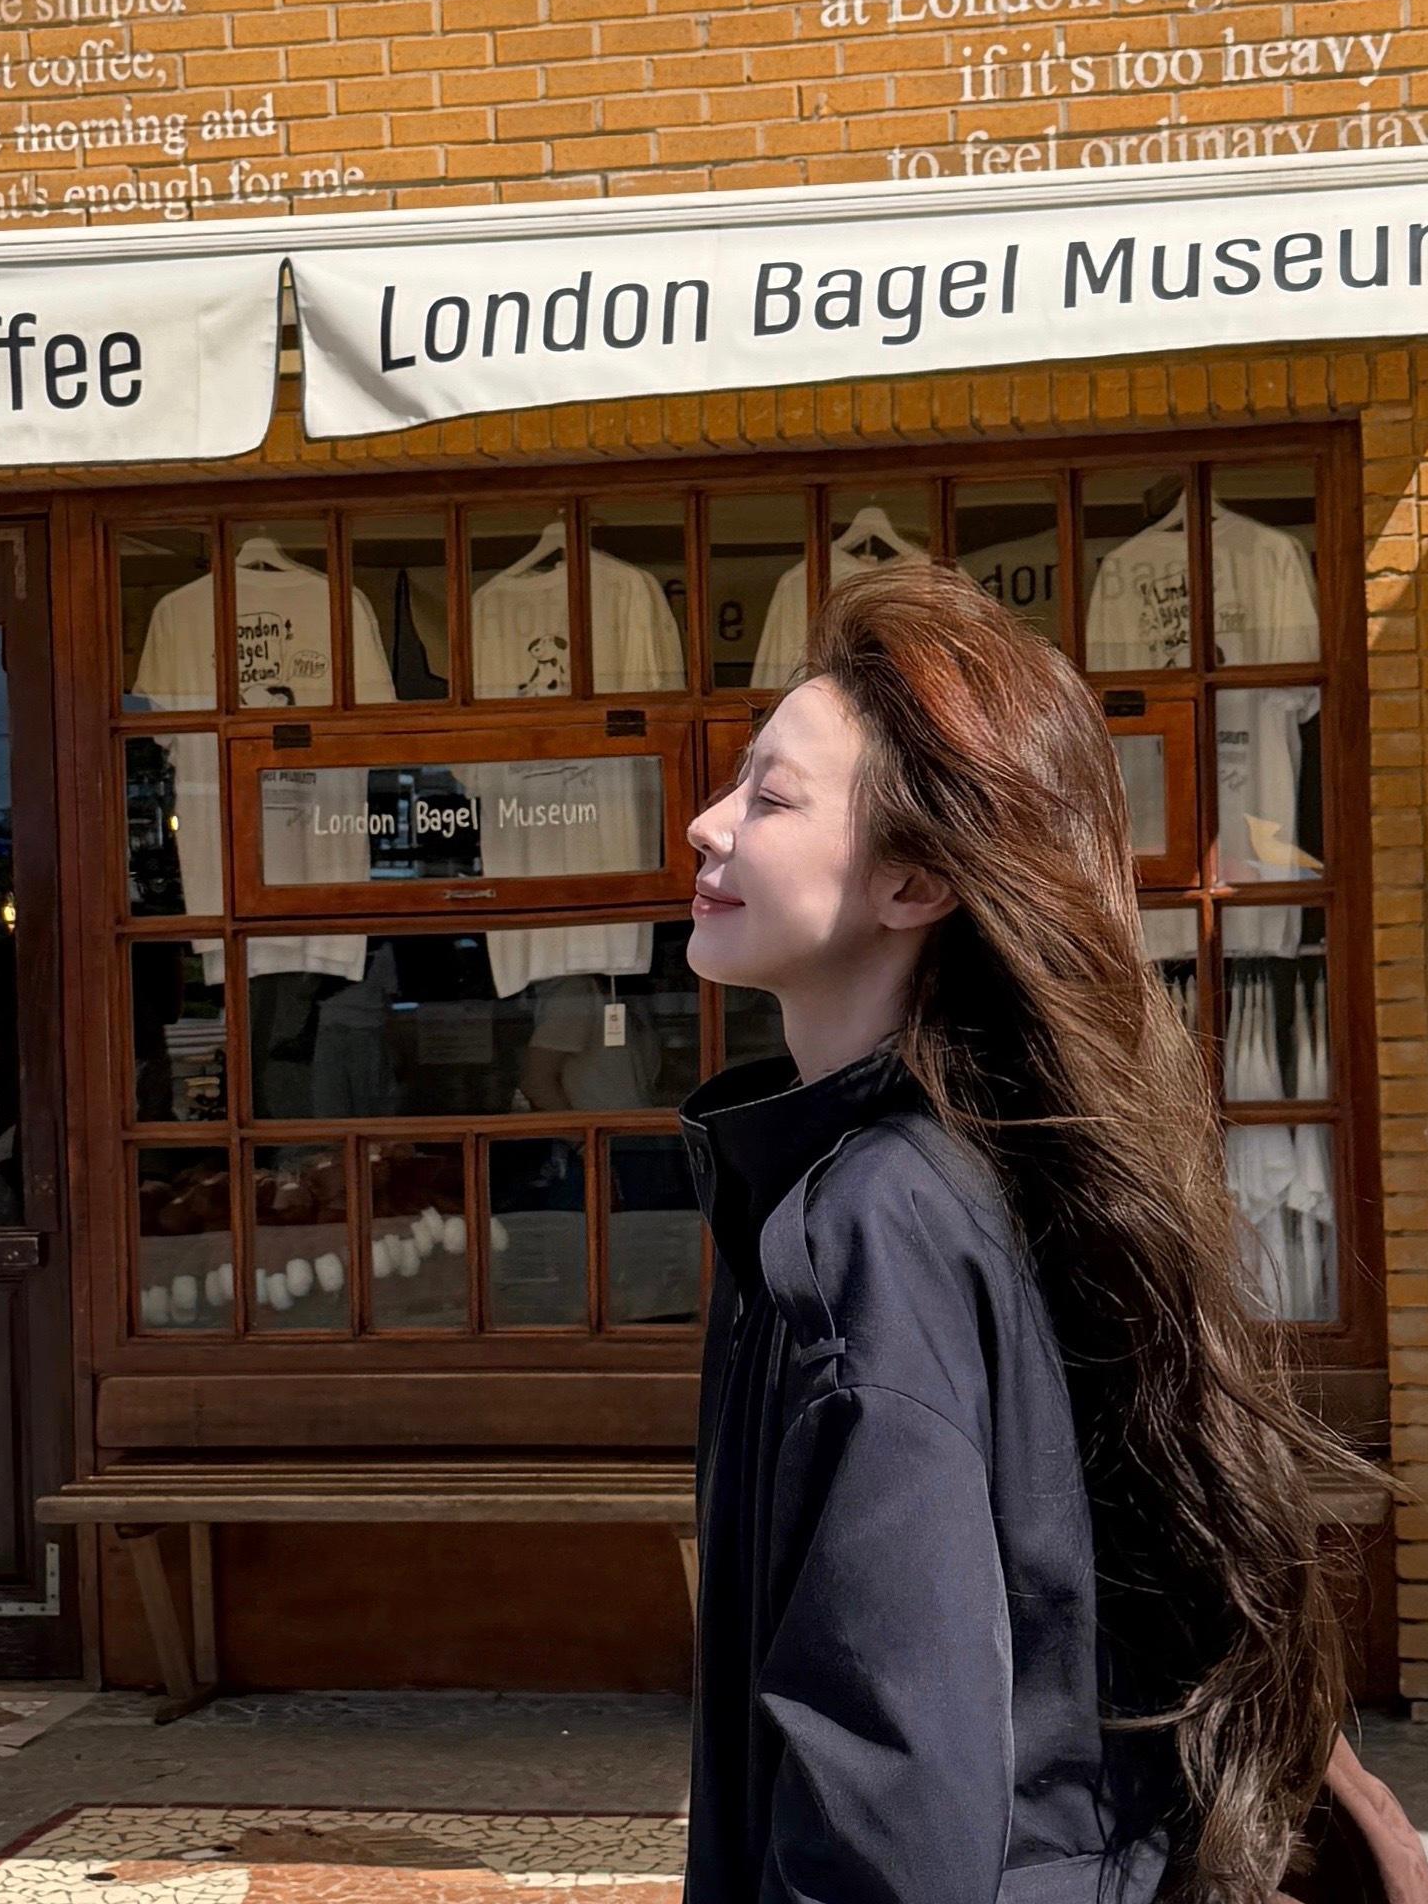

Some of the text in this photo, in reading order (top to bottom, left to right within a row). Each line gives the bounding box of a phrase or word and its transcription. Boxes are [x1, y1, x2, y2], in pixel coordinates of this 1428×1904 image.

[28, 38, 168, 88] coffee,
[960, 28, 1392, 102] if it's too heavy
[14, 104, 188, 155] morning
[201, 92, 277, 140] and
[887, 145, 940, 181] to
[961, 125, 1057, 177] feel
[1080, 114, 1319, 168] ordinary
[64, 163, 213, 220] enough
[228, 161, 288, 202] for
[301, 166, 376, 198] me.
[380, 270, 711, 374] London
[752, 243, 1018, 346] Bagel
[237, 616, 279, 639] ondon
[237, 640, 268, 667] agel
[314, 798, 598, 838] London Bagel Museum
